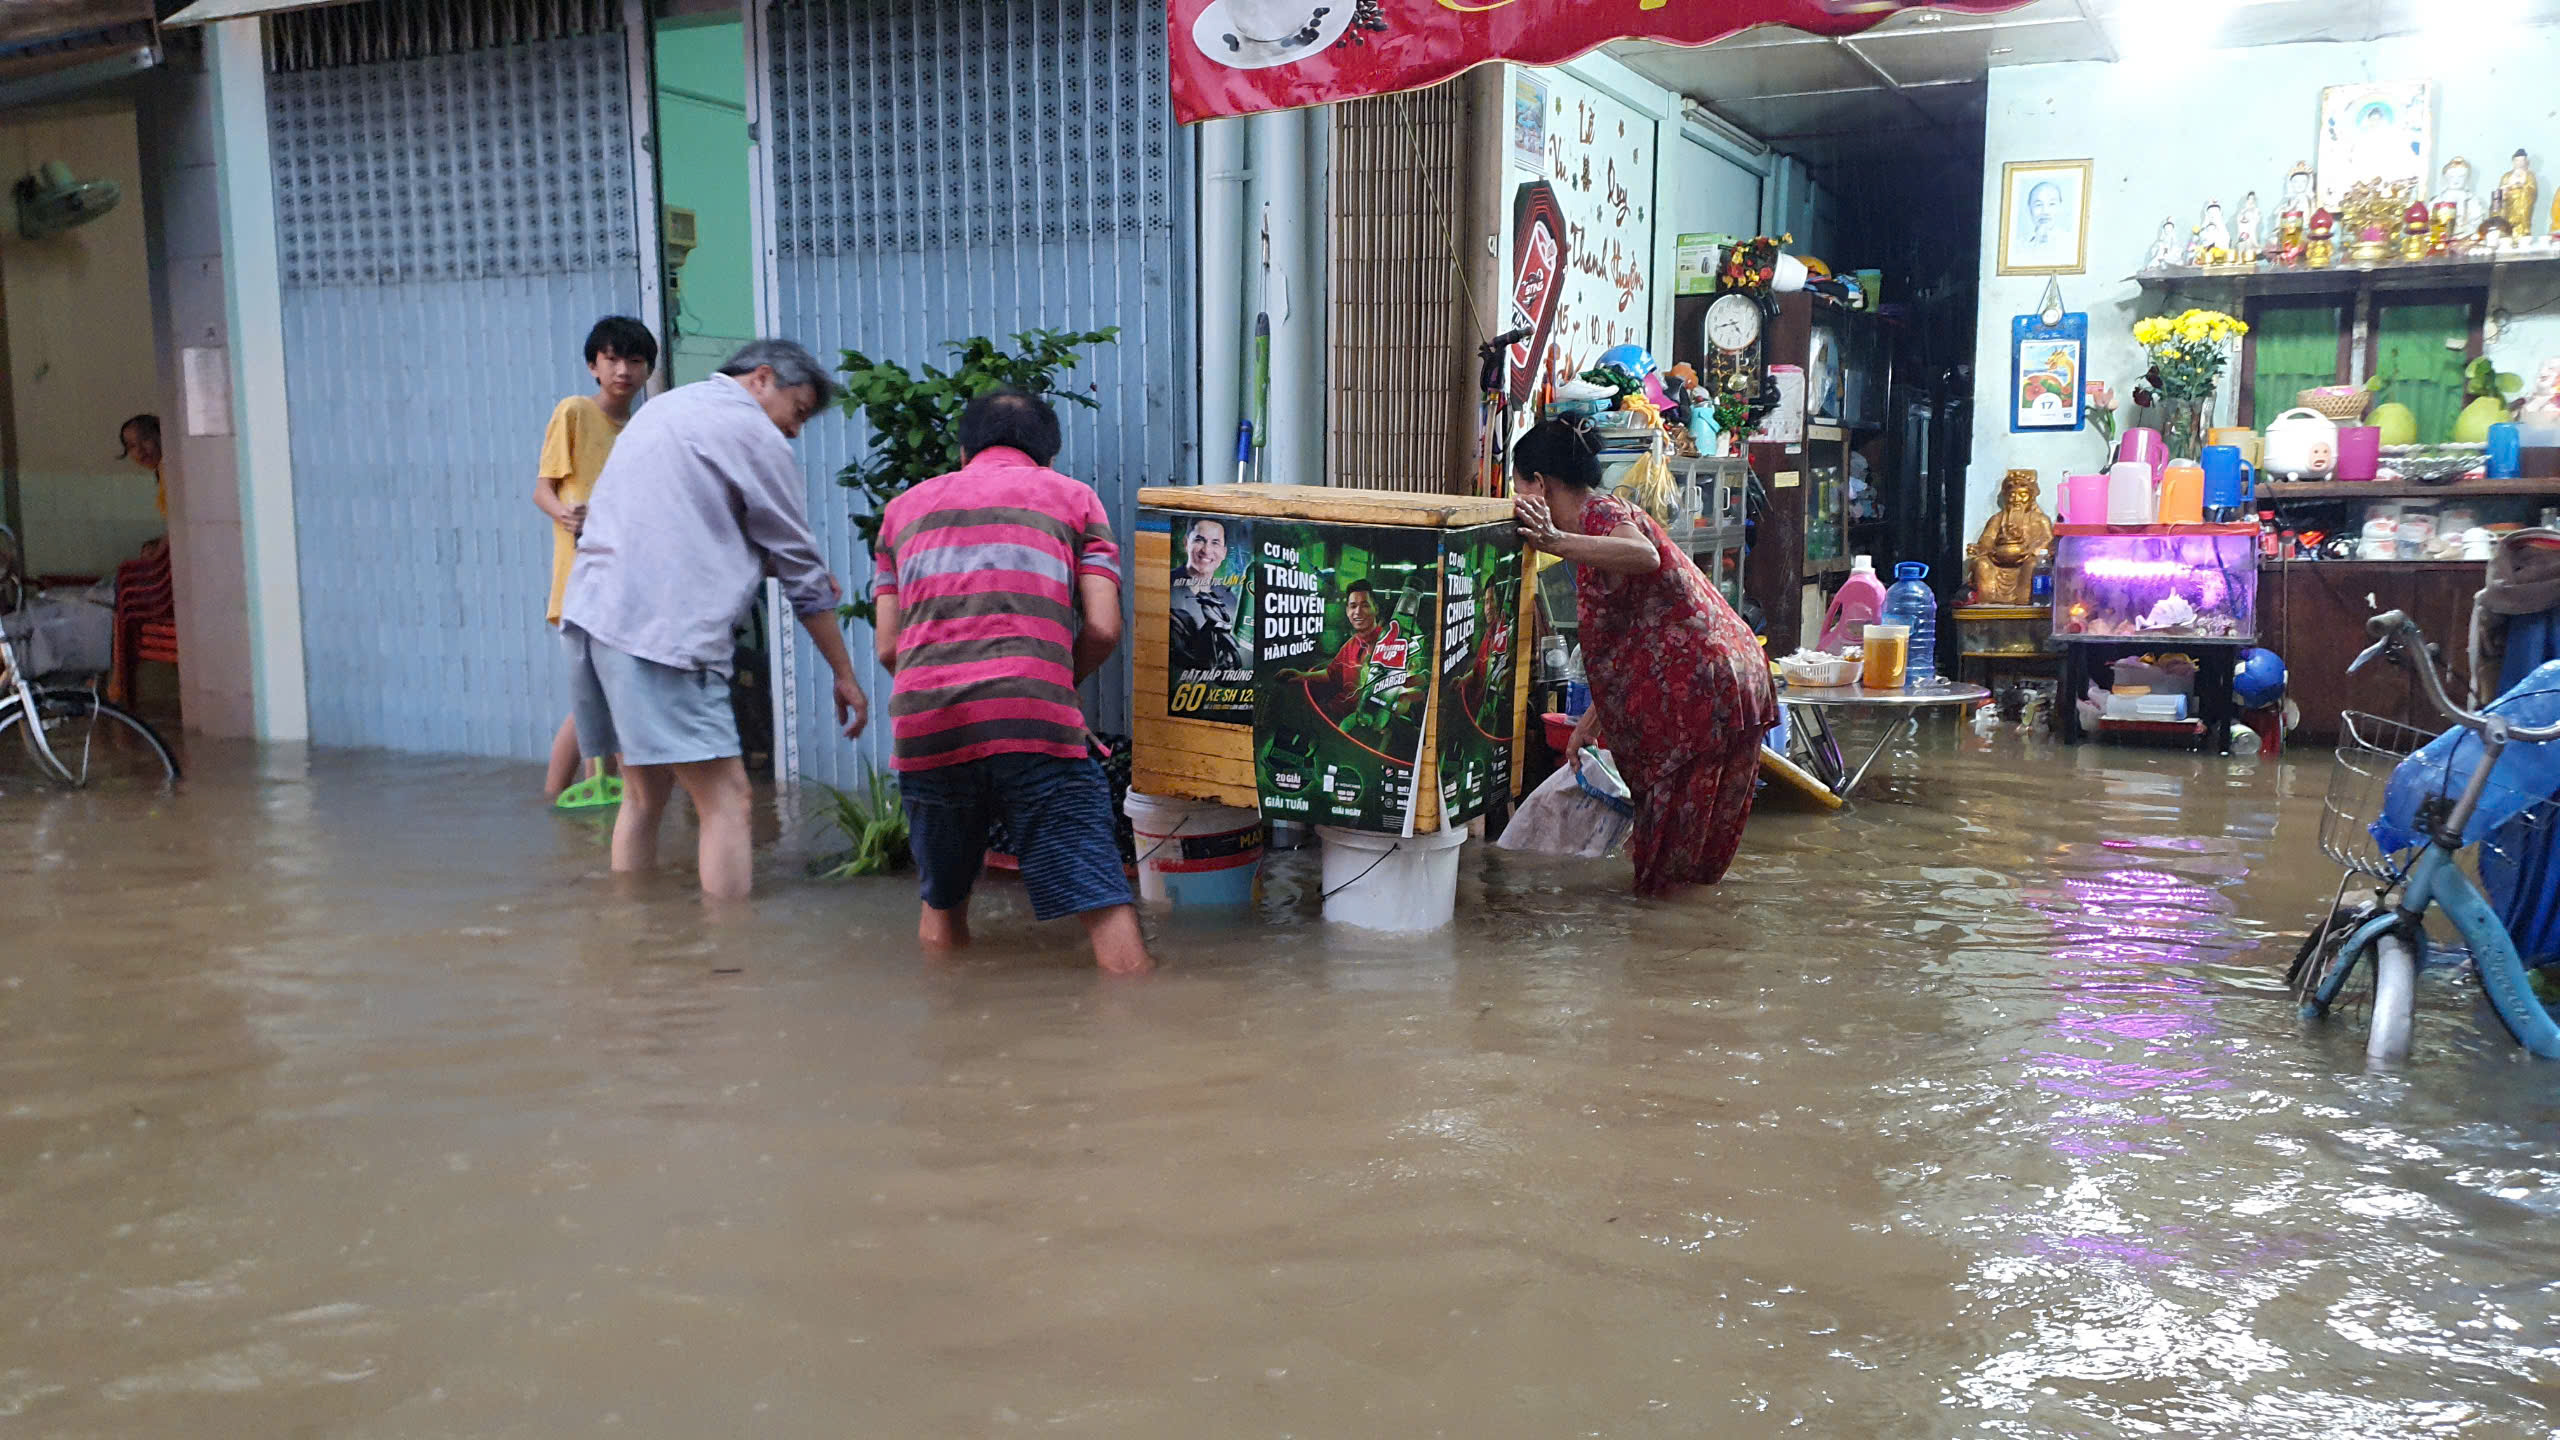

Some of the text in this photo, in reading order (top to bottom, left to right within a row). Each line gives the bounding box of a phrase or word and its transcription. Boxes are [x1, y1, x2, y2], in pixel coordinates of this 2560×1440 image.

[1264, 542, 1299, 565] CƠ HỘI
[1264, 564, 1317, 591] TRÚNG
[1448, 570, 1473, 596] TRÚNG
[1264, 592, 1325, 614] CHUYẾN
[1446, 595, 1476, 625] CHUYẾN
[1264, 616, 1324, 639] DU LỊCH
[1264, 639, 1316, 661] HÀN QUỐC
[1377, 644, 1405, 654] Thums
[1445, 628, 1459, 652] DU
[1221, 668, 1254, 682] TRÚNG
[1373, 672, 1407, 694] CHARGED
[1171, 683, 1207, 712] 60
[1207, 688, 1222, 702] XE
[1222, 688, 1238, 702] SH
[1275, 773, 1288, 783] 20
[1265, 795, 1284, 808] GIẢI
